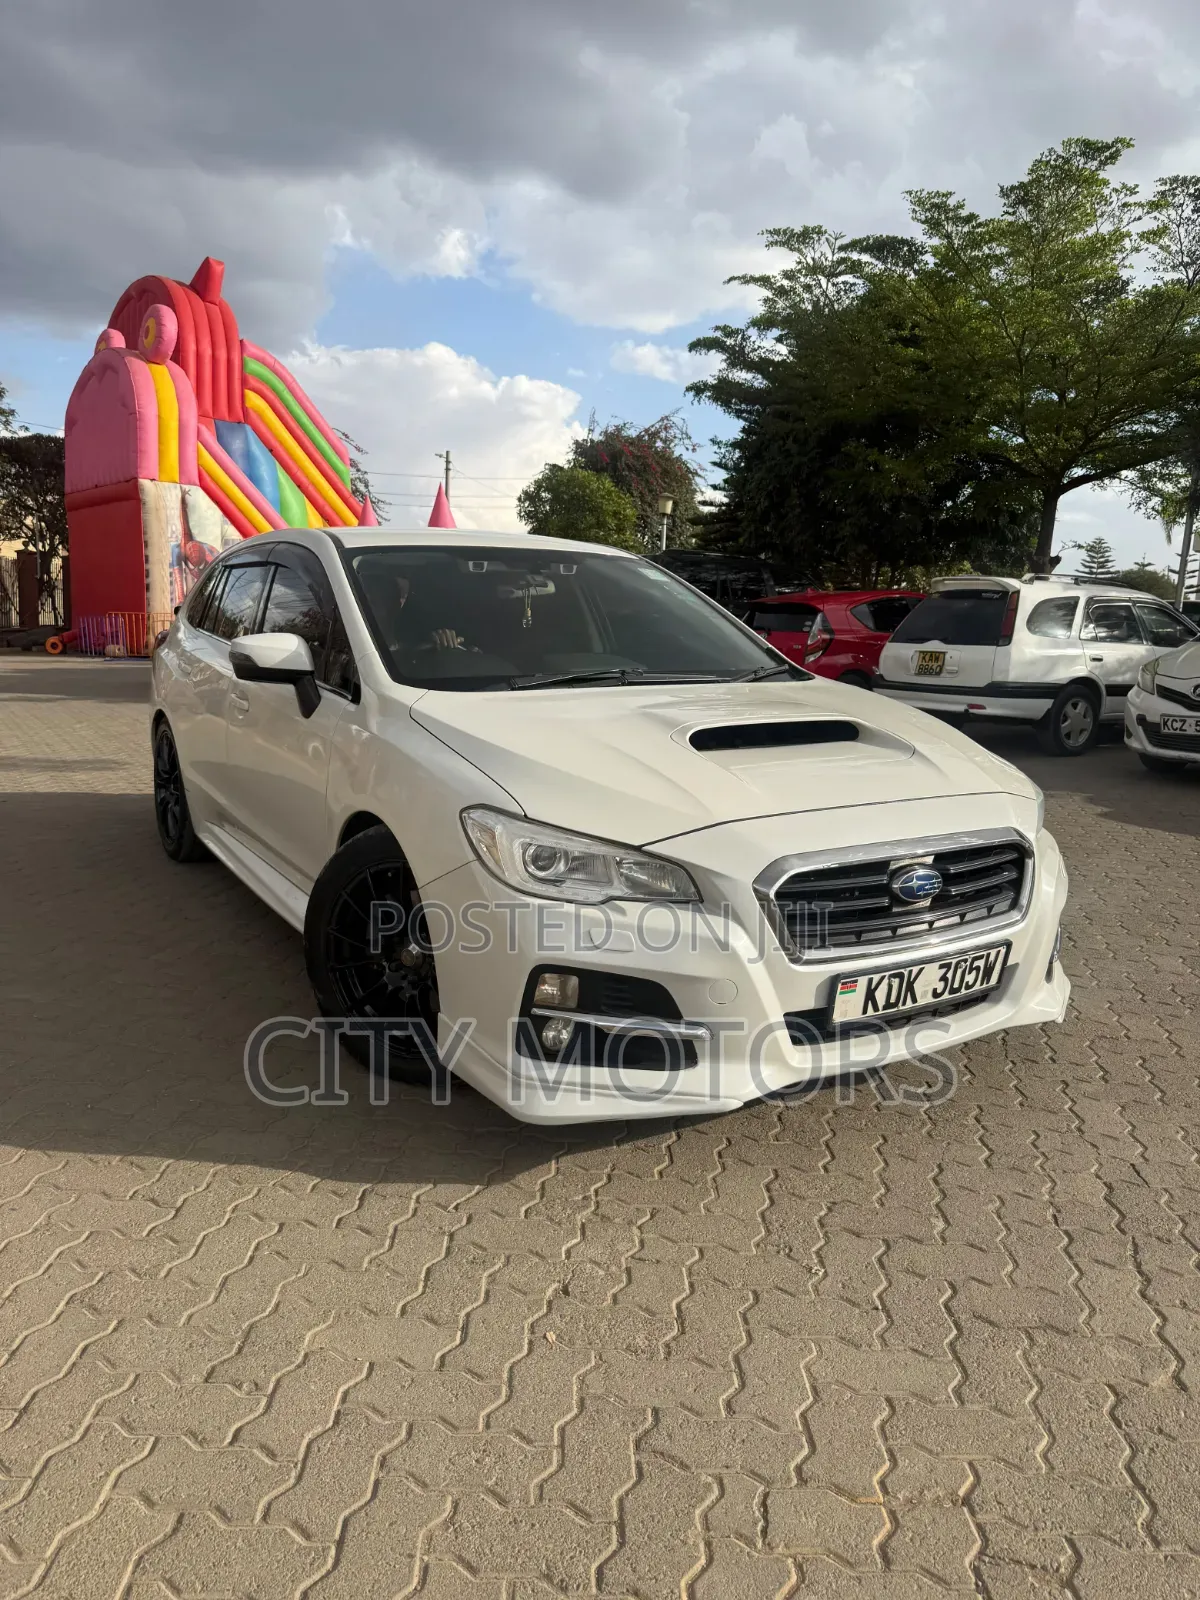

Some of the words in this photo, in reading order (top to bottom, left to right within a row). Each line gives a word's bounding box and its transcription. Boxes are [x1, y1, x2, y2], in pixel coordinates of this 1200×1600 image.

[921, 652, 941, 664] KAW
[1162, 717, 1188, 732] KCZ
[861, 966, 926, 1016] KDK
[931, 949, 1001, 999] 305W
